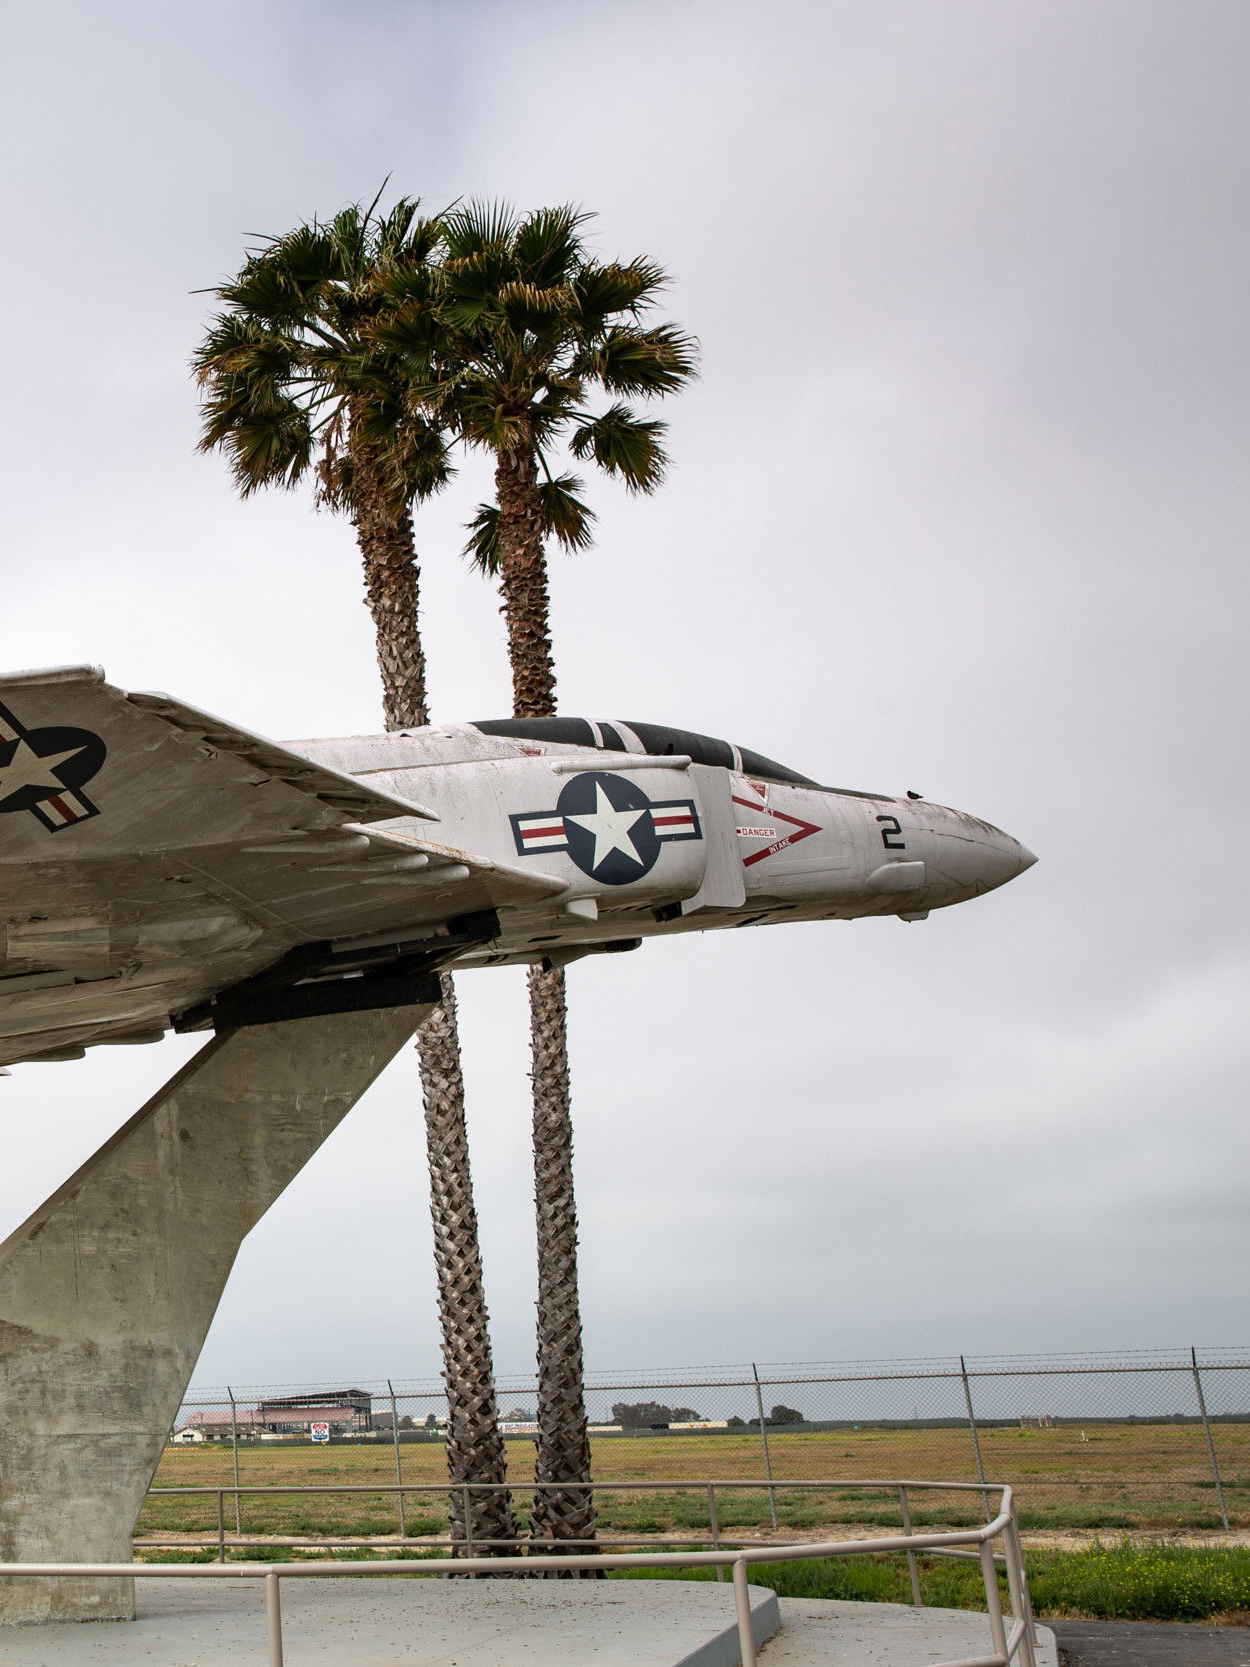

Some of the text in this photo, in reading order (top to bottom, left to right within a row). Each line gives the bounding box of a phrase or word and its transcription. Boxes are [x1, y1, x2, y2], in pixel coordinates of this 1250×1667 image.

[762, 807, 774, 816] JET
[742, 828, 775, 836] DANGER
[875, 815, 906, 849] 2
[768, 838, 791, 854] INTAKE
